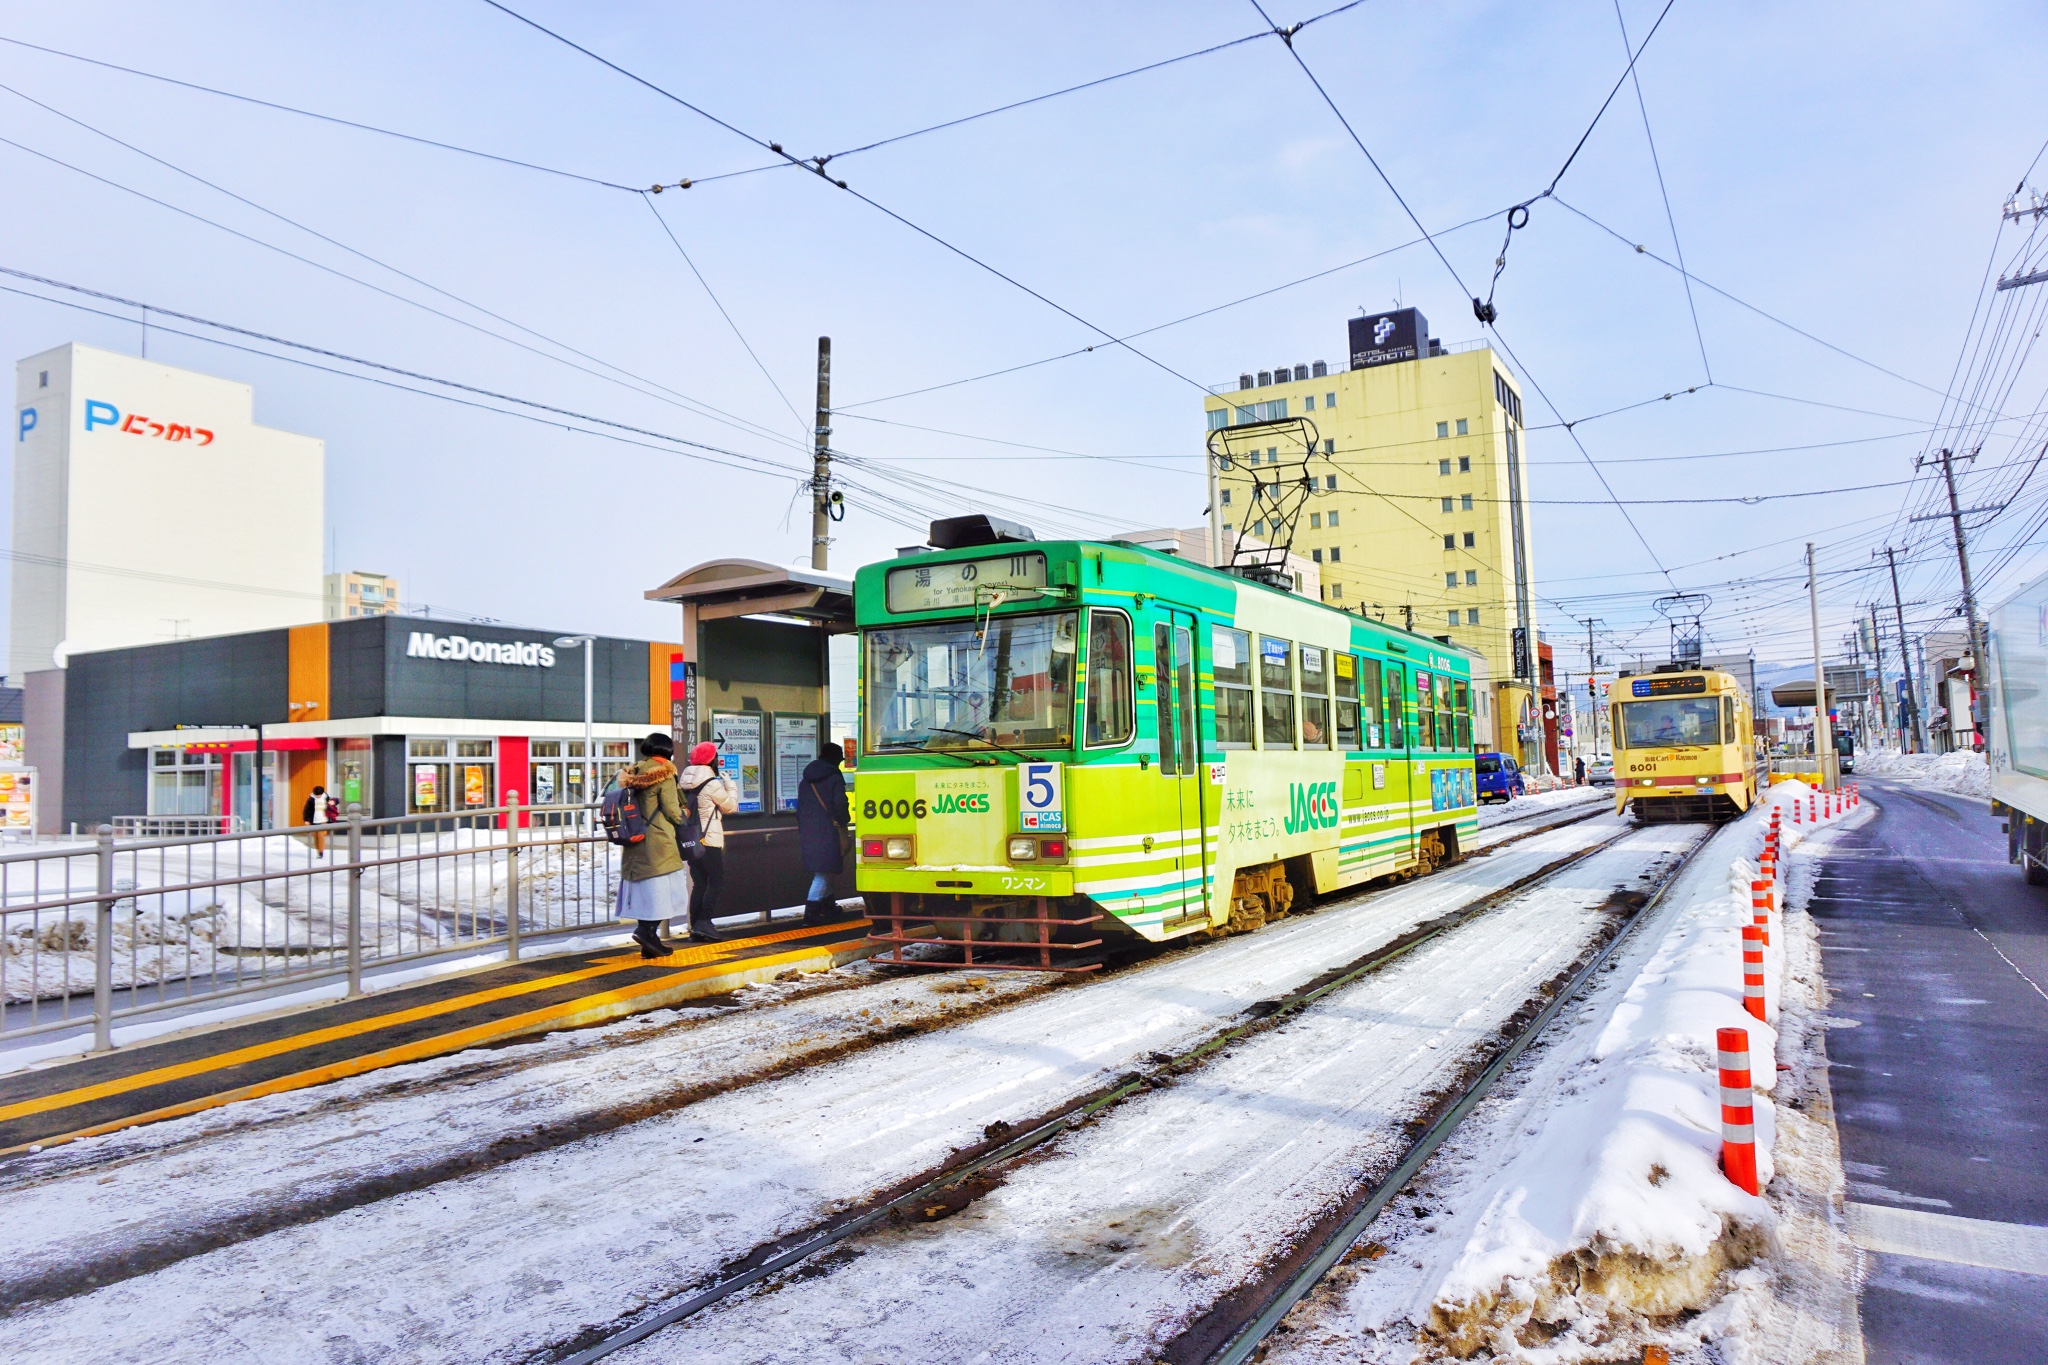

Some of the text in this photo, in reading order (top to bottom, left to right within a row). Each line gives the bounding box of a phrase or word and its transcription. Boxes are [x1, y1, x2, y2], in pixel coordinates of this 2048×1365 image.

[1353, 349, 1385, 359] HOTEL
[19, 407, 37, 442] P
[84, 398, 214, 446] P にっかつ
[933, 588, 943, 596] for
[407, 632, 556, 668] McDonald's
[686, 665, 696, 761] 五稜郭公園前方面
[1630, 763, 1657, 772] 8001
[933, 781, 990, 789] 未来にタネをまこう。
[1026, 765, 1054, 808] 5
[863, 798, 927, 819] 8006
[931, 794, 990, 814] JACCS
[1227, 788, 1254, 811] 未来に
[1283, 781, 1338, 835] JACCS
[1039, 812, 1061, 821] ICAS
[1348, 806, 1390, 825] www.jaccs.co.jp
[1228, 817, 1280, 844] タネをまこう。
[1001, 876, 1046, 890] ワンマン
